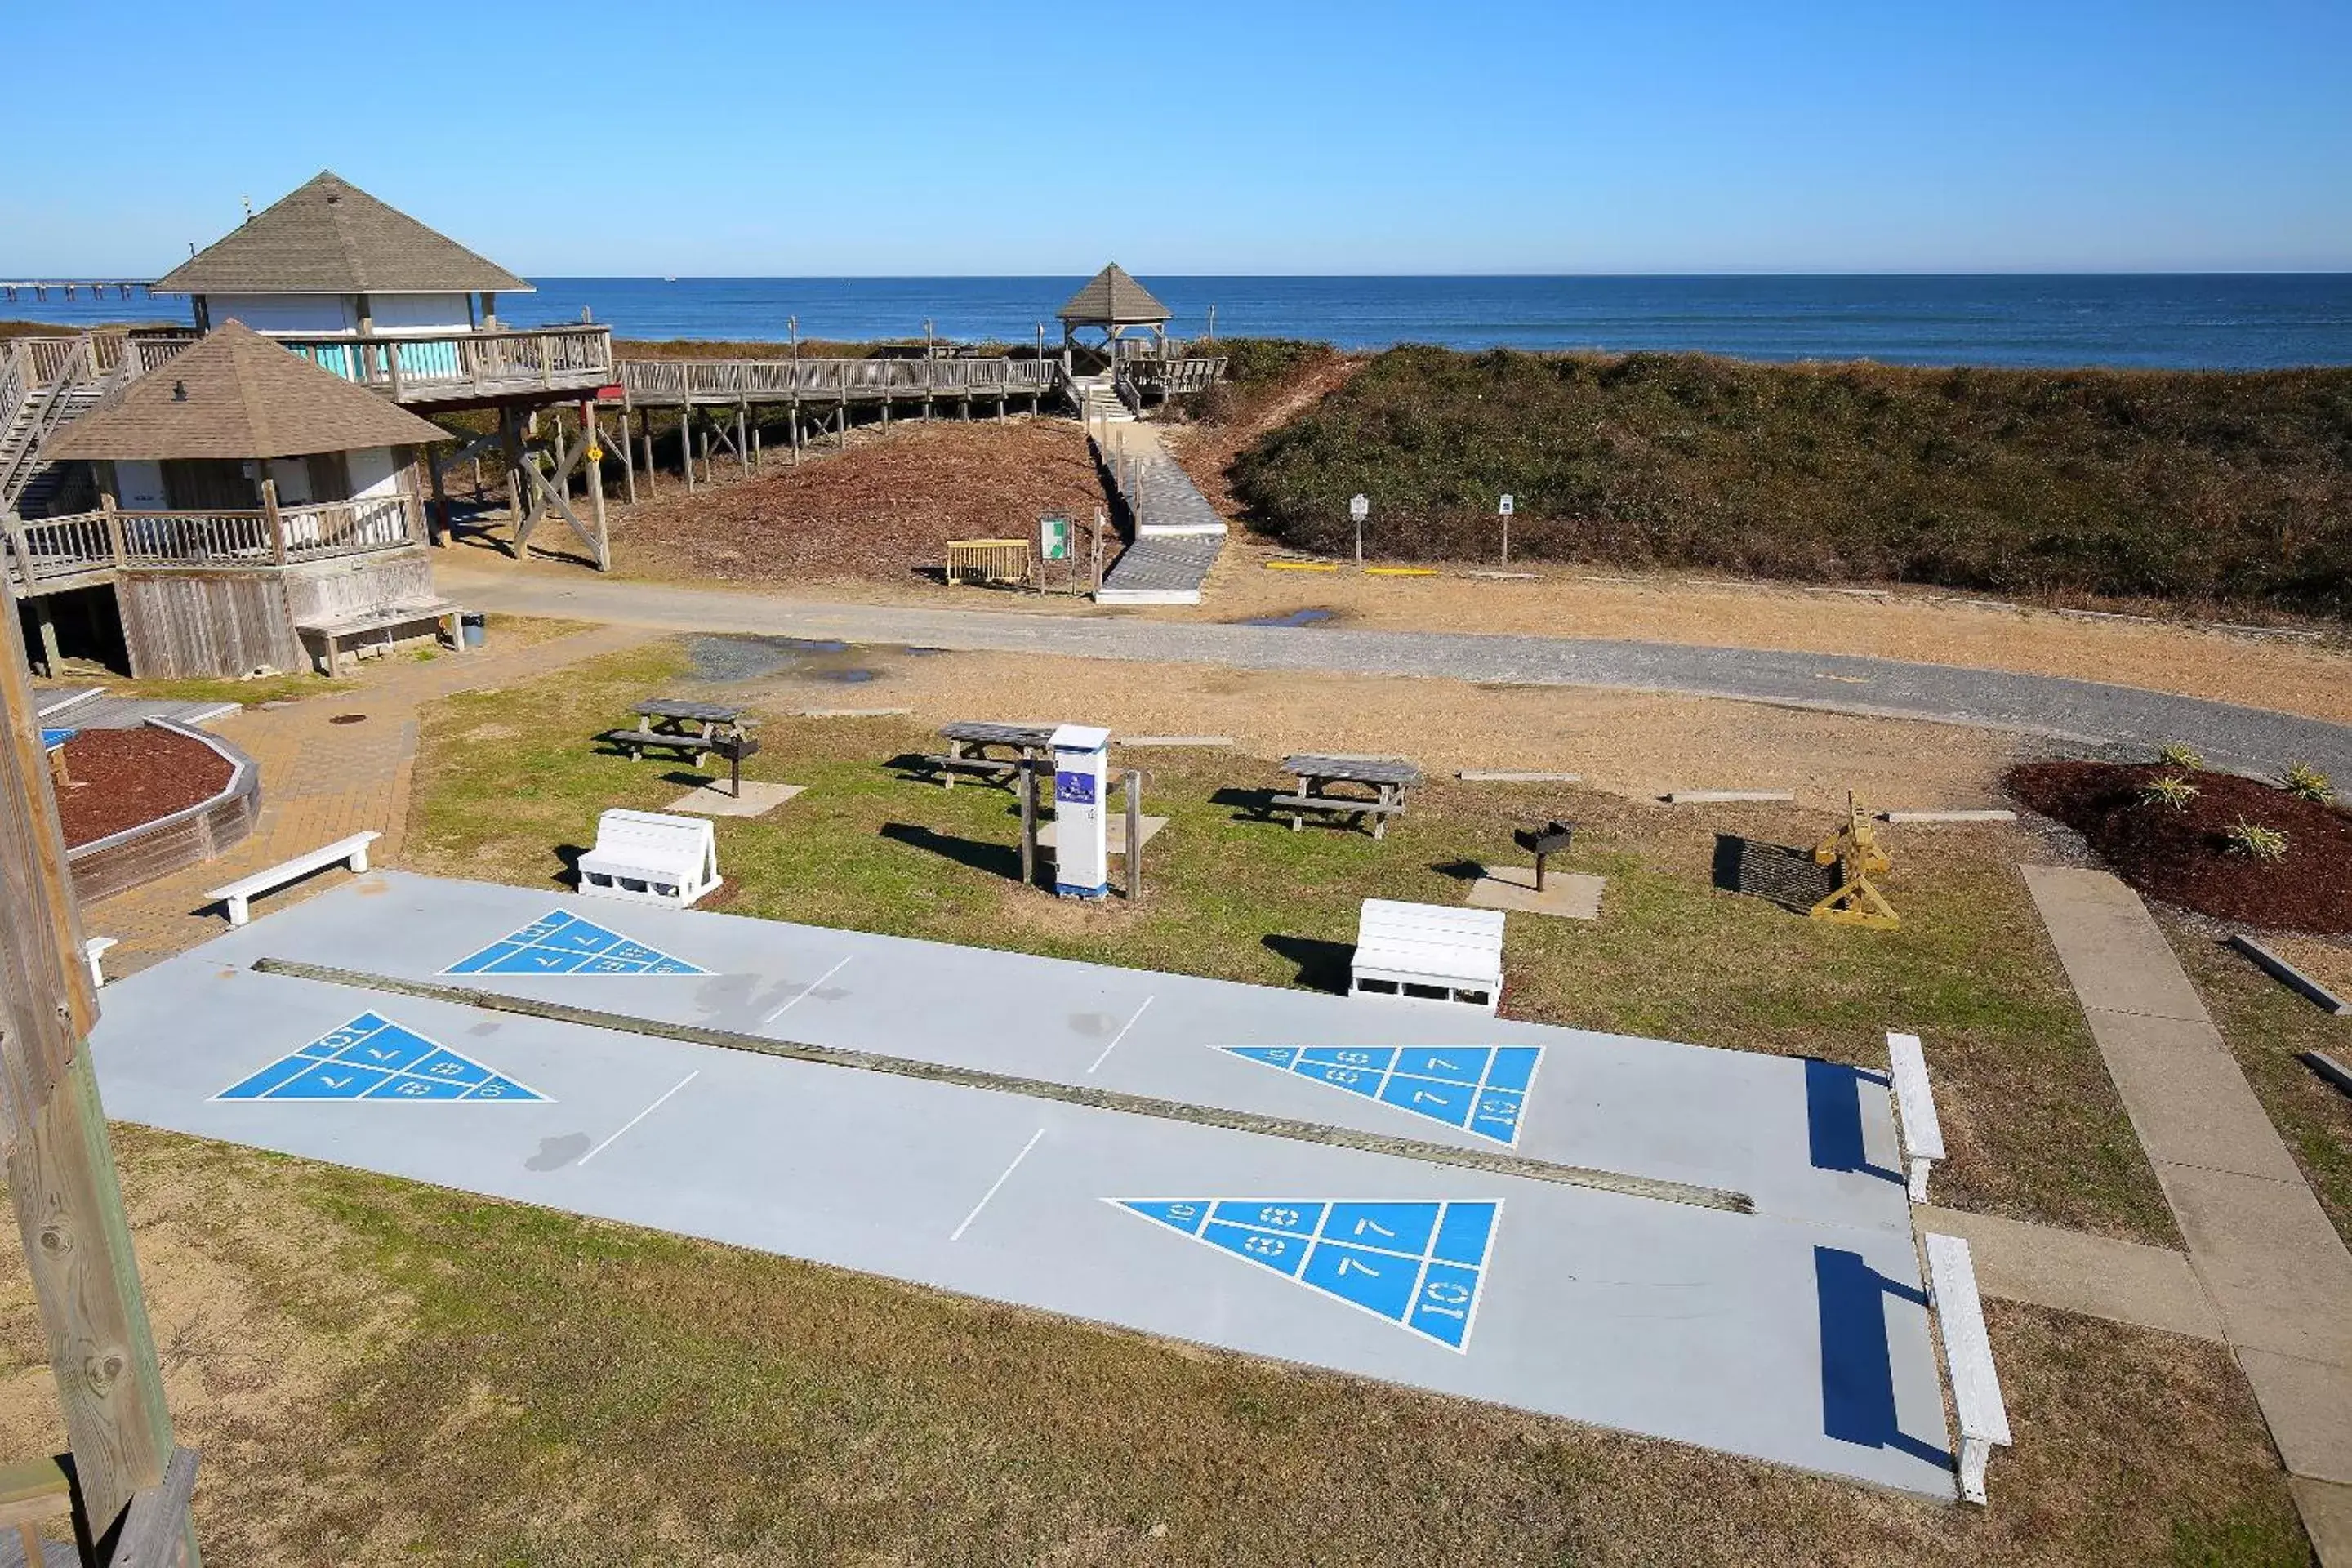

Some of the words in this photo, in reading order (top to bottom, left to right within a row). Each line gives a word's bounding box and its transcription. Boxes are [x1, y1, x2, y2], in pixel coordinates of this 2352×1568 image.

[573, 937, 600, 946] 7
[536, 957, 564, 967] 7
[320, 1027, 370, 1048] 10
[368, 1049, 402, 1062] 7
[1337, 1051, 1370, 1063] 8
[430, 1062, 465, 1075] 8
[1427, 1058, 1463, 1071] 7
[319, 1076, 355, 1089] 7
[1325, 1070, 1359, 1084] 8
[395, 1081, 431, 1095] 8
[1414, 1090, 1449, 1104] 7
[1479, 1100, 1517, 1125] 10
[1165, 1204, 1196, 1221] 10
[1259, 1205, 1299, 1227] 8
[1354, 1217, 1396, 1237] 7
[1244, 1236, 1286, 1257] 8
[1337, 1256, 1379, 1277] 7
[1421, 1281, 1468, 1319] 10
